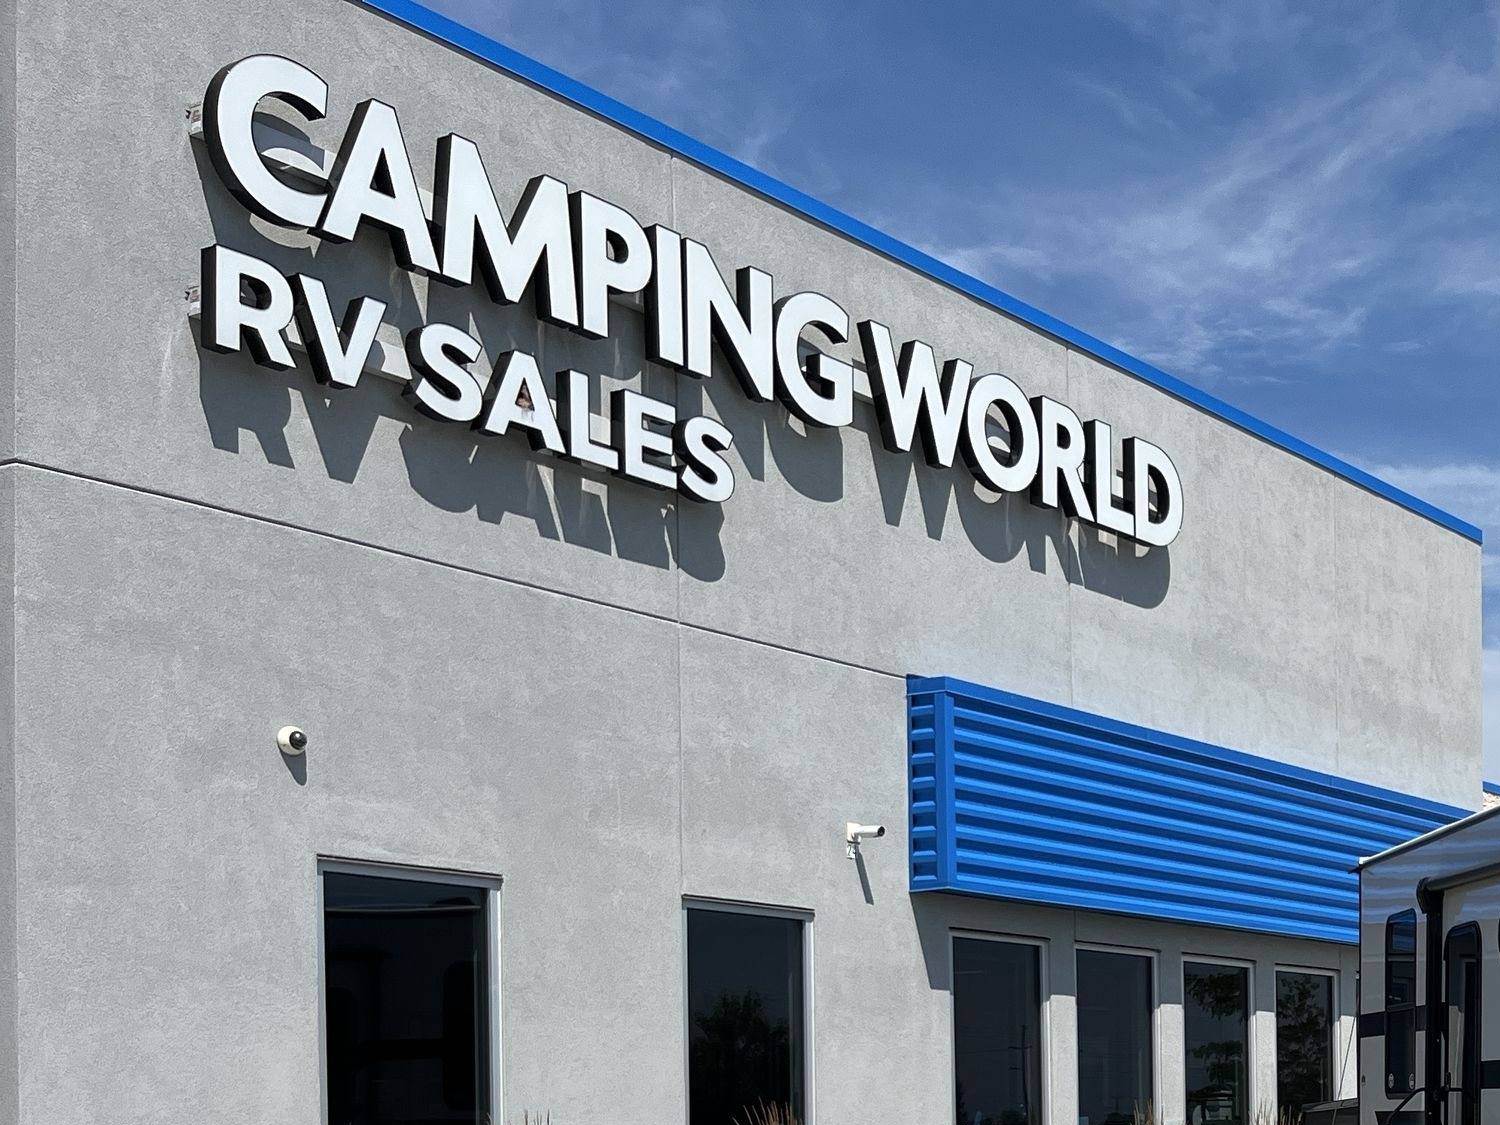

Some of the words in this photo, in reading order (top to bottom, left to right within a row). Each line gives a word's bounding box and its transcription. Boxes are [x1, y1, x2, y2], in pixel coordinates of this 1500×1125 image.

[201, 244, 388, 388] RV
[406, 323, 735, 503] SALES
[203, 54, 854, 428] CAMPING
[857, 320, 1184, 547] WORLD
